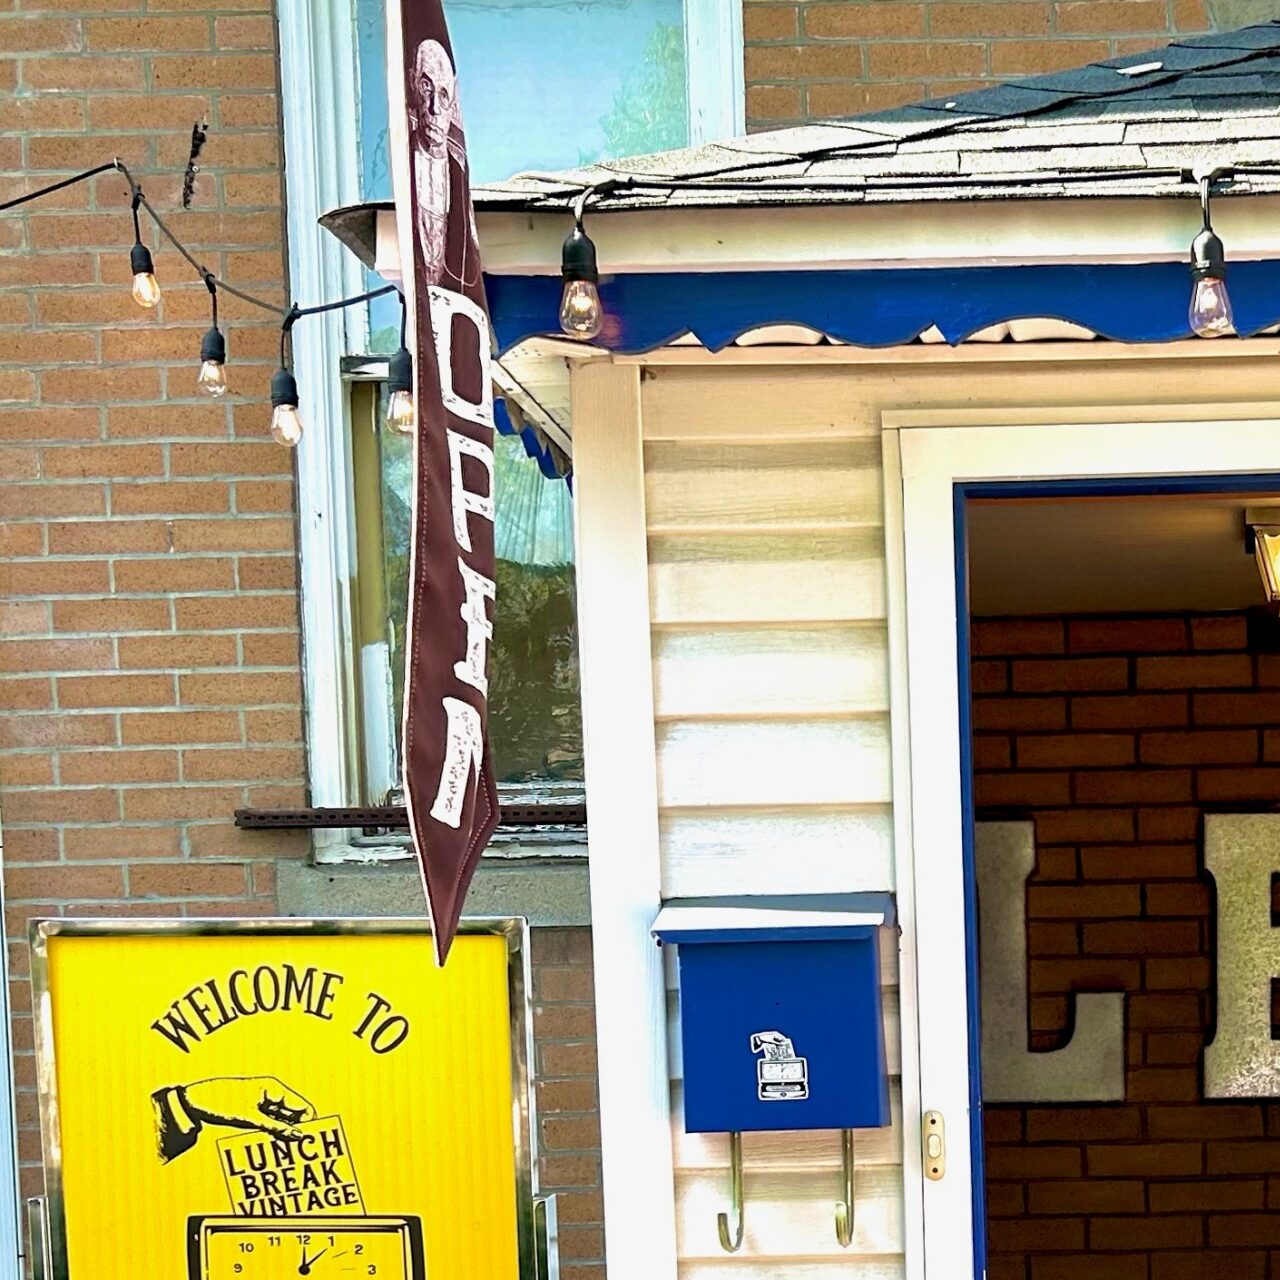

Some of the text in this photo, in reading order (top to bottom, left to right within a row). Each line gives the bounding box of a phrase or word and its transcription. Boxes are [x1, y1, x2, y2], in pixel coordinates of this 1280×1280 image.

[150, 963, 410, 1055] WELCOME TO
[224, 1129, 344, 1176] LUNCH
[241, 1159, 343, 1200] BREAK
[237, 1183, 359, 1216] VINTAGE
[268, 1236, 281, 1247] 11
[296, 1235, 311, 1245] 12
[327, 1236, 335, 1247] 1
[239, 1243, 254, 1253] 10
[354, 1244, 364, 1255] 2
[233, 1263, 243, 1273] 9
[367, 1264, 377, 1275] 3
